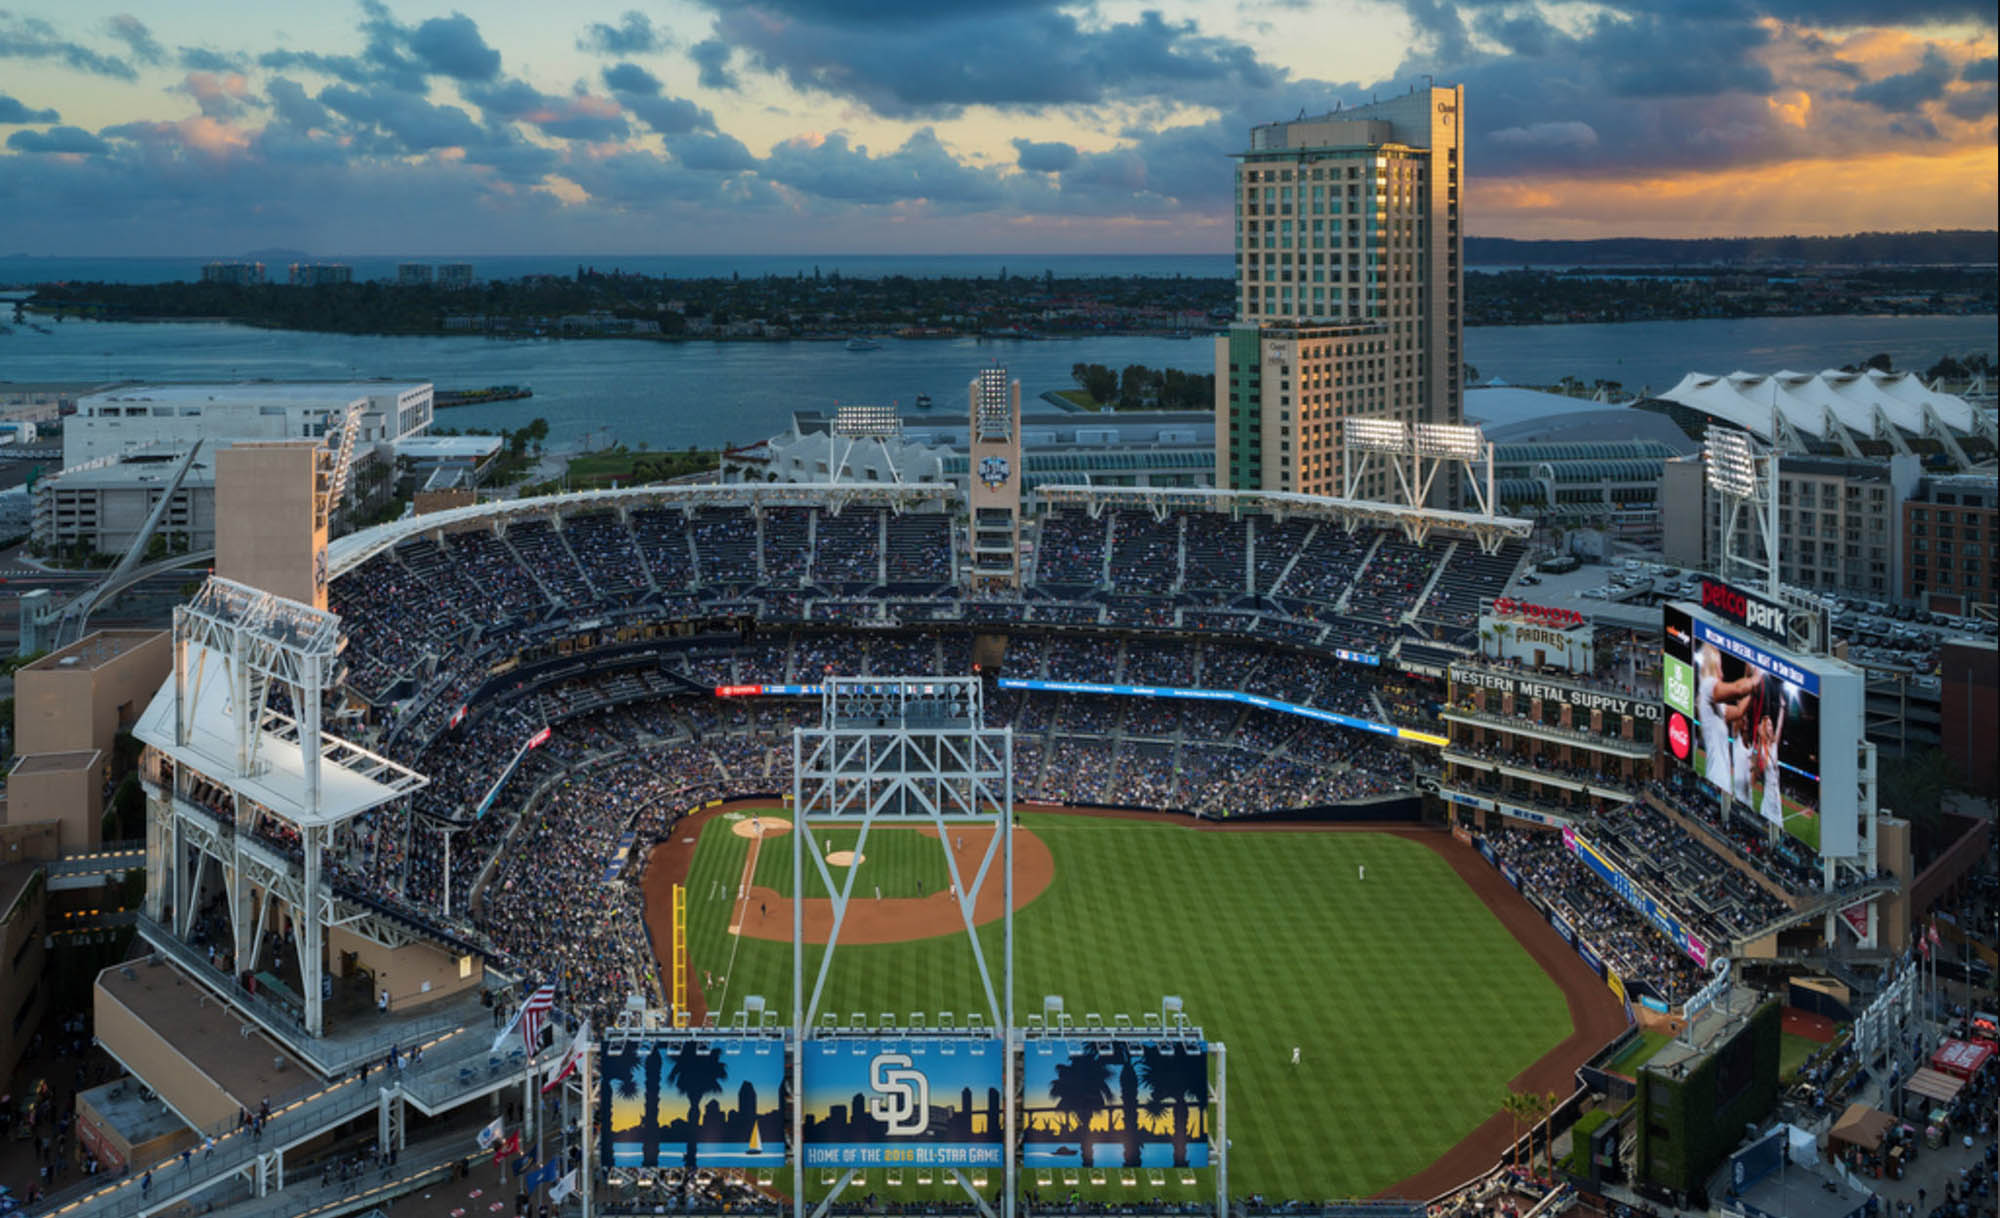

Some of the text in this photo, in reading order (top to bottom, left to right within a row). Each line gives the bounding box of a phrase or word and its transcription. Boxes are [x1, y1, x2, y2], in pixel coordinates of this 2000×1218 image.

[1520, 602, 1585, 625] TOYOTA
[1516, 627, 1565, 652] PADRES
[1451, 670, 1514, 692] WESTERN
[1520, 682, 1569, 703] METAL
[1571, 691, 1631, 714] SUPPLY
[1635, 704, 1663, 721] CO.
[870, 1053, 929, 1136] SD
[808, 1148, 840, 1163] HOME
[843, 1148, 857, 1163] OF
[860, 1148, 881, 1163] THE
[884, 1149, 914, 1162] 2016
[969, 1148, 1000, 1163] GAME
